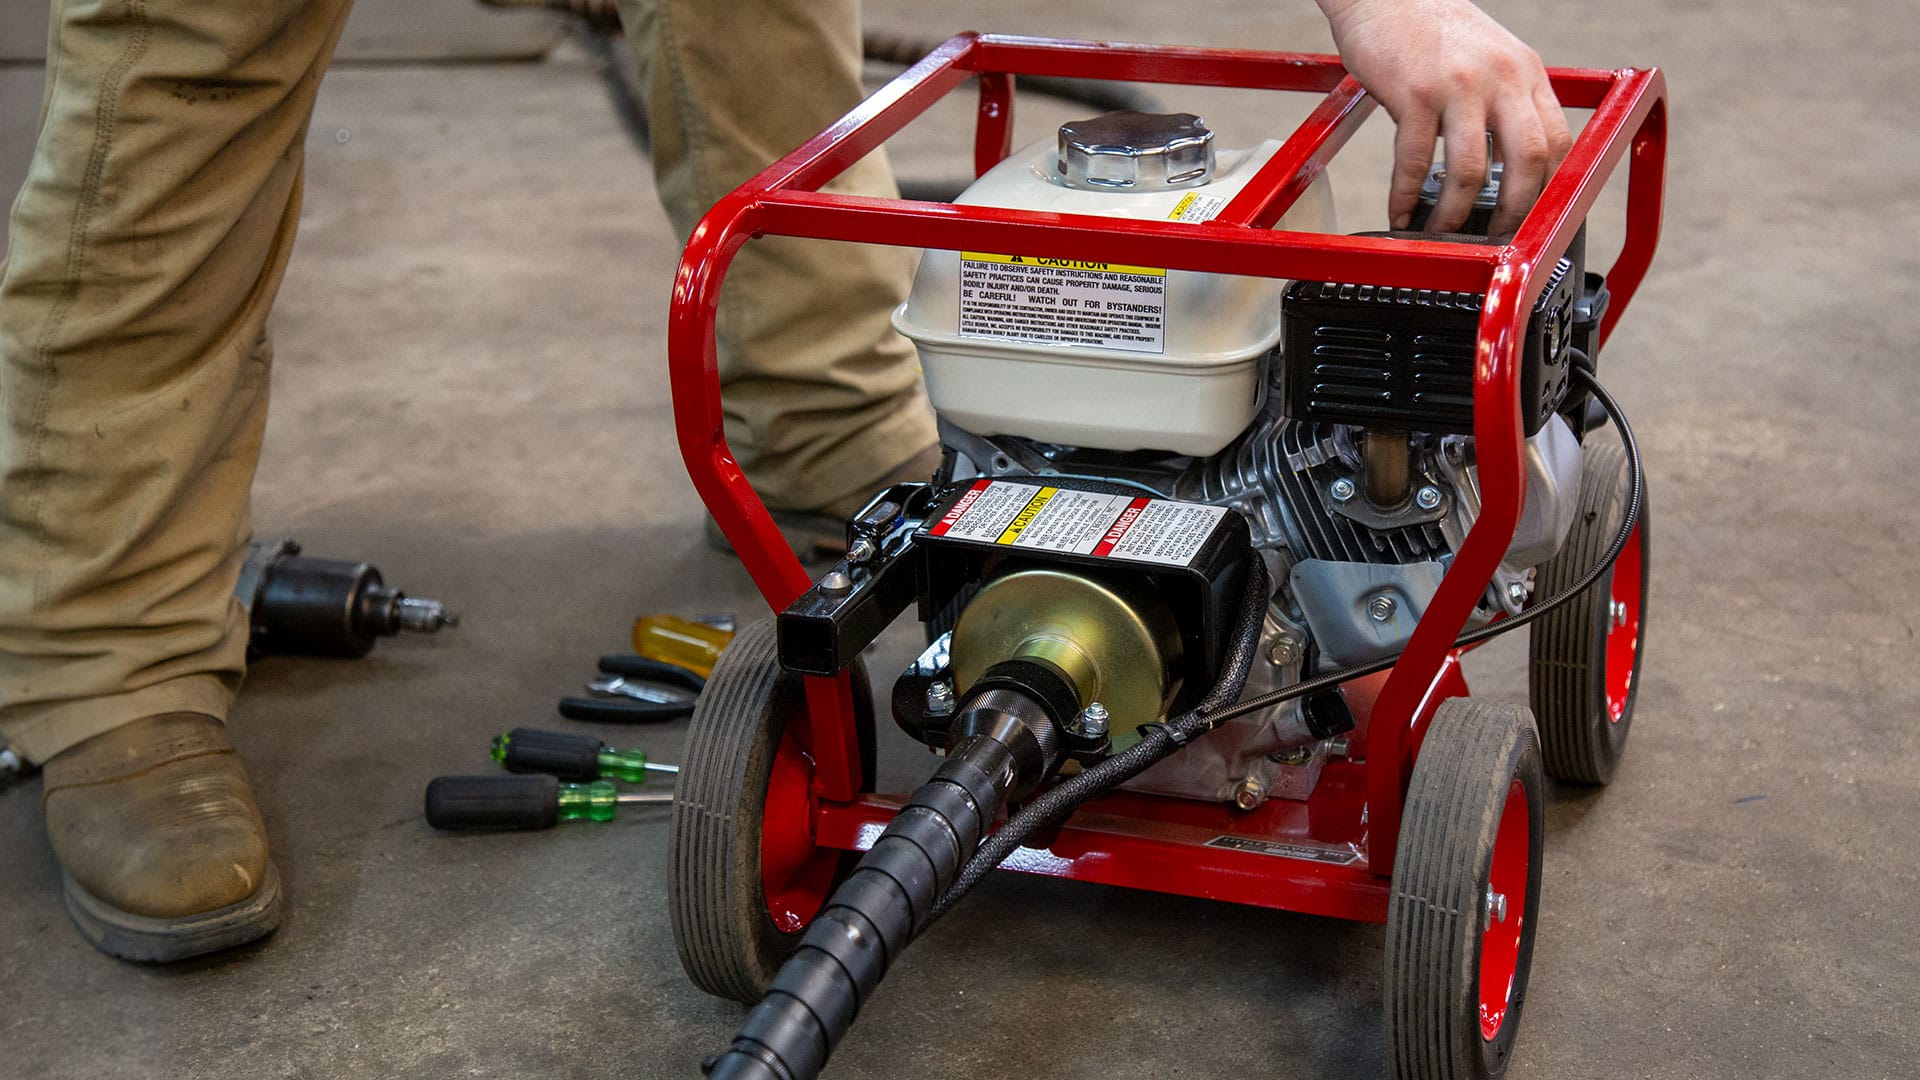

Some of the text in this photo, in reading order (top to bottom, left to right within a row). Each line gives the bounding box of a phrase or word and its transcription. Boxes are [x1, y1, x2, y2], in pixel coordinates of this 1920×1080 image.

[963, 271, 986, 280] SAFETY
[989, 273, 1024, 282] PRACTICES
[1042, 277, 1064, 286] CAUSE
[1066, 279, 1100, 288] PROPERTY
[1102, 282, 1132, 292] DAMAGE,
[1134, 285, 1162, 294] SERIOUS
[963, 280, 1060, 295] BODILY INJURY AND/OR DEATH.
[964, 262, 989, 270] FAILURE
[1000, 265, 1028, 274] OBSERVE
[1030, 267, 1054, 276] SAFETY
[1056, 269, 1103, 279] INSTRUCTIONS
[1120, 274, 1163, 284] REASONABLE
[963, 290, 1161, 314] BE CAREFUL! WATCH OUT FOR BYSTANDERS!
[946, 489, 983, 518] DANGER
[1012, 496, 1048, 527] CAUTION
[1107, 507, 1142, 538] DANGER
[1114, 544, 1127, 553] THE
[1121, 529, 1139, 544] CLUTCH
[1132, 519, 1147, 529] DRUM
[1140, 508, 1155, 519] MUST
[1124, 532, 1146, 552] INSTALLED
[1146, 505, 1166, 524] FASTENED
[1131, 504, 1177, 556] OVER SHOE DRIVE ASSEMBLY
[1142, 539, 1160, 555] BEFORE
[1153, 522, 1173, 539] STARTING
[1153, 540, 1172, 557] SERIOUS
[1166, 526, 1182, 540] BODILY
[1176, 514, 1192, 526] INJURY
[1163, 510, 1204, 556] DEATH MAY RESULT FROM
[1170, 545, 1188, 561] CLUTCH
[1181, 533, 1197, 545] SHOES
[1190, 517, 1208, 533] THROWN
